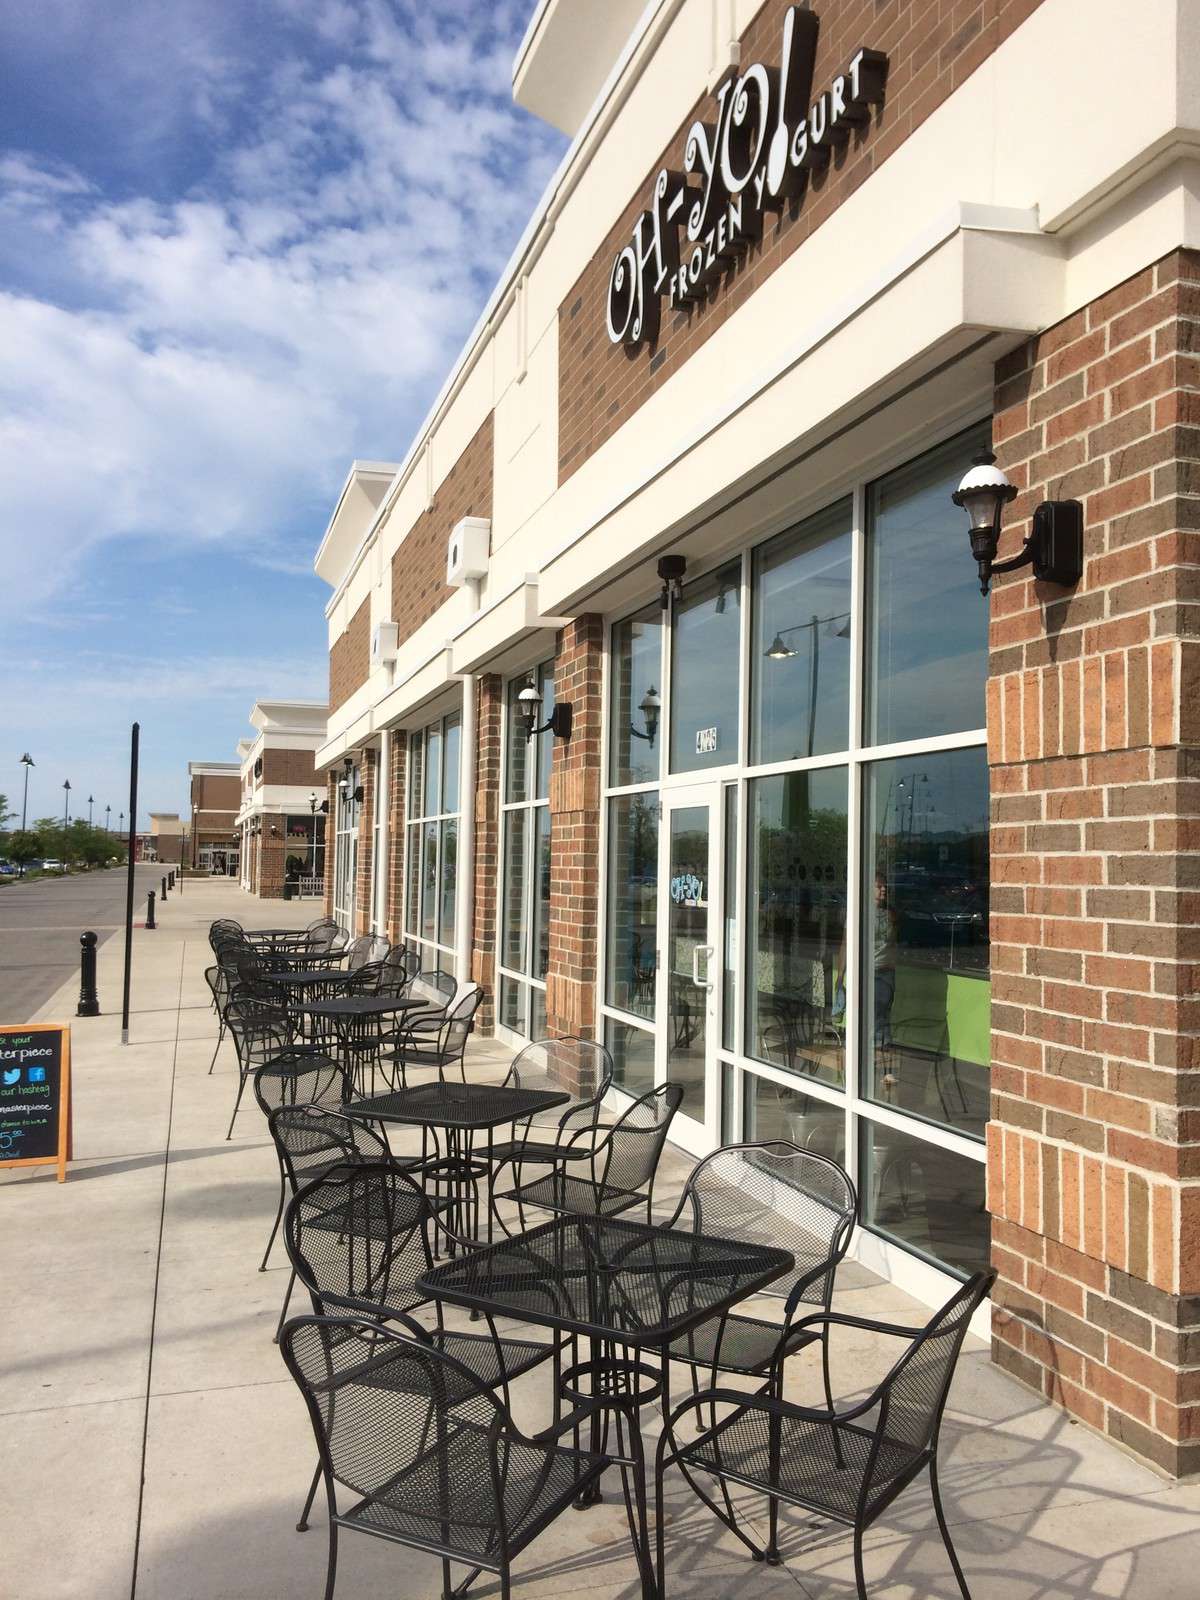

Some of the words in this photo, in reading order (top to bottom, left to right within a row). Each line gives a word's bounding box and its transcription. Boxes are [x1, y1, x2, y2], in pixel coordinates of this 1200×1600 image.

[670, 195, 742, 308] FROZEN
[12, 1035, 32, 1047] your
[18, 1082, 50, 1098] hashtag
